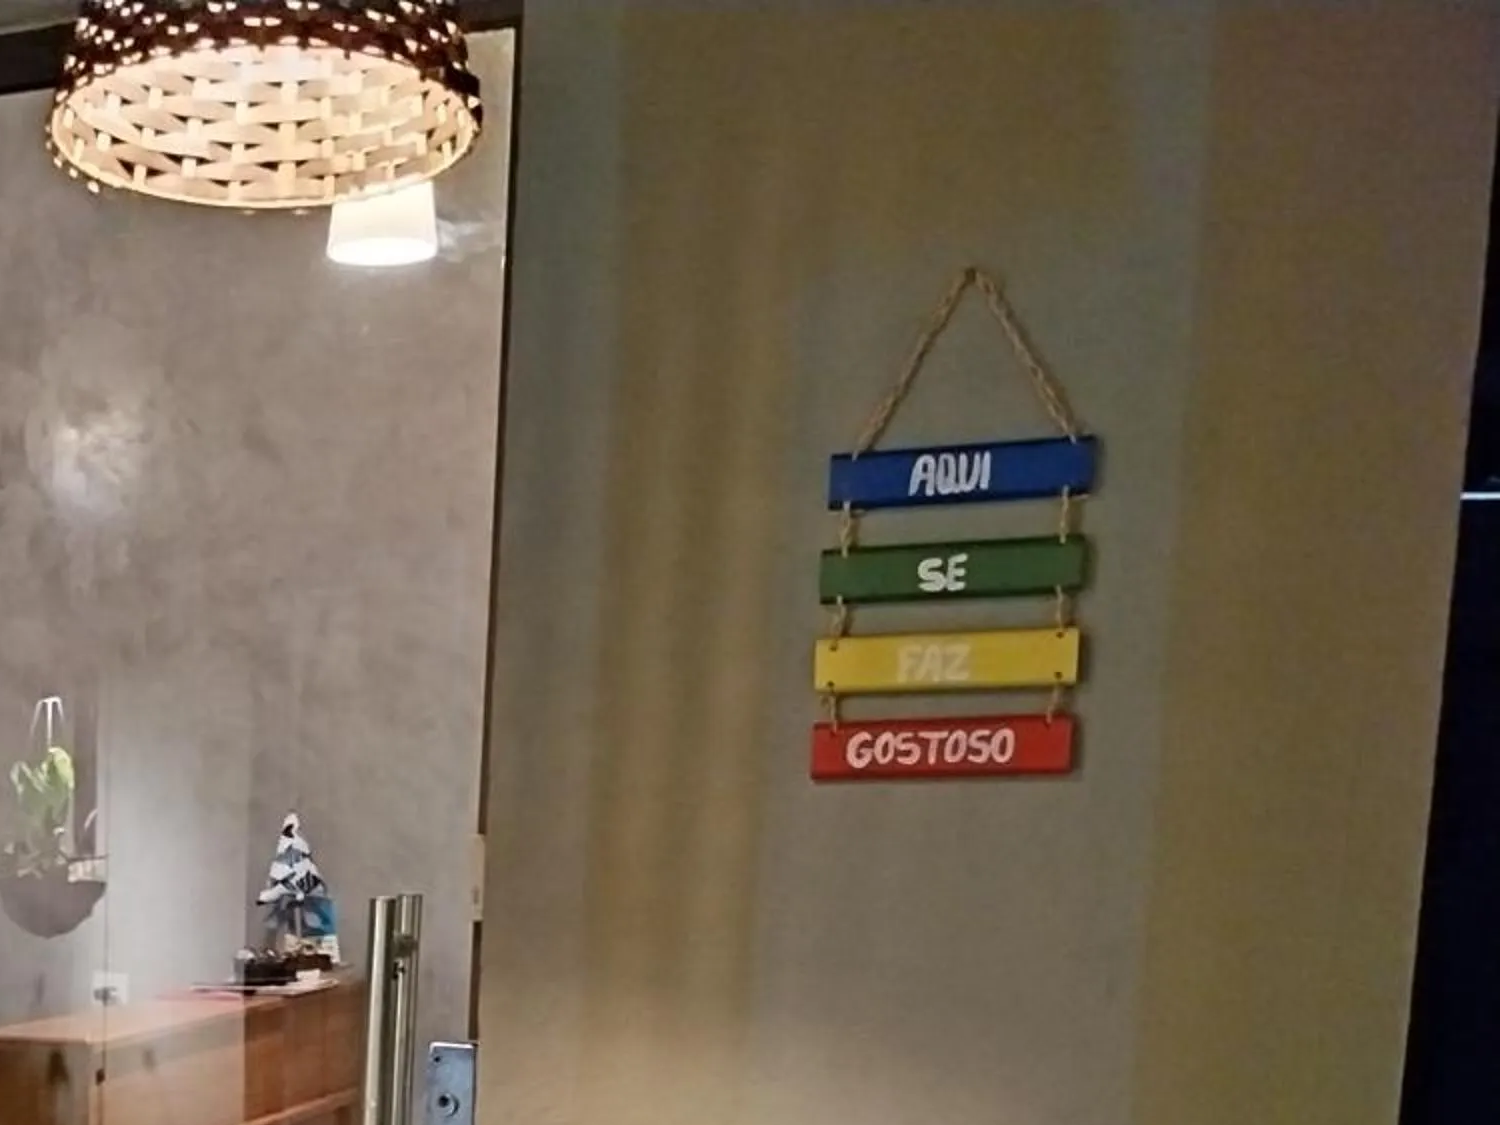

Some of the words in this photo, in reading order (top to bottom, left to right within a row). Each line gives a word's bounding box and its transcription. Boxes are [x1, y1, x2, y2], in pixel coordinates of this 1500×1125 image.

[908, 451, 992, 496] AQUI
[917, 553, 969, 592] SE
[897, 644, 972, 682] FAZ
[845, 728, 1016, 769] GOSTOSO
